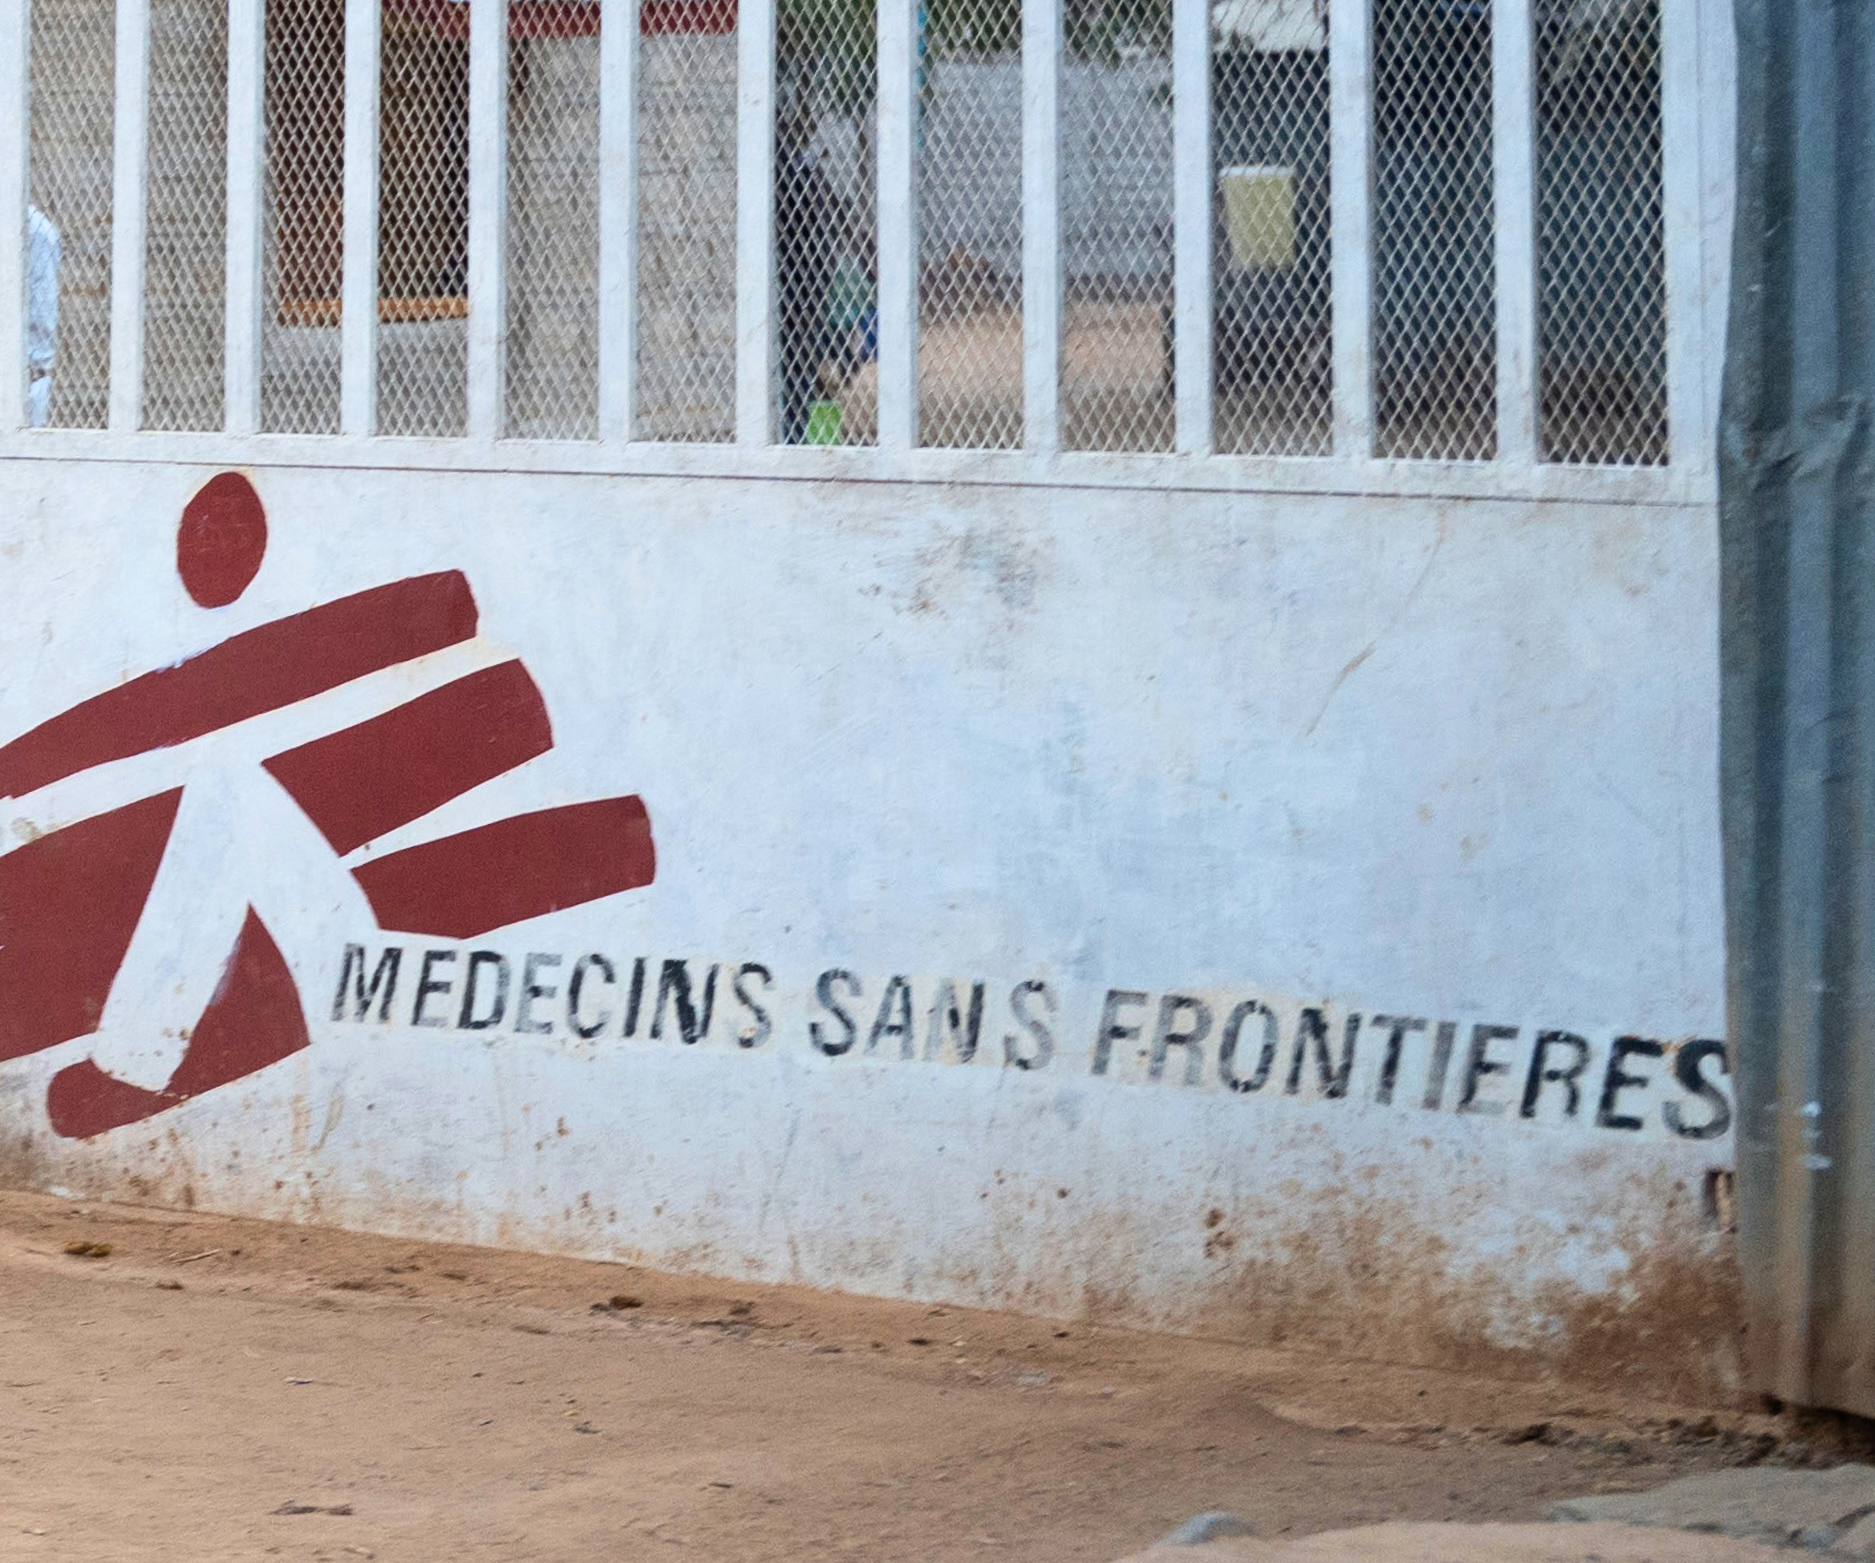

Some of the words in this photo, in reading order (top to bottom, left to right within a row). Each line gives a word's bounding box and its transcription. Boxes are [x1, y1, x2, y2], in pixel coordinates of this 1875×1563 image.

[330, 942, 776, 1049] MEDECINS
[808, 969, 1060, 1071] SANS
[1089, 988, 1731, 1140] FRONTIERES
